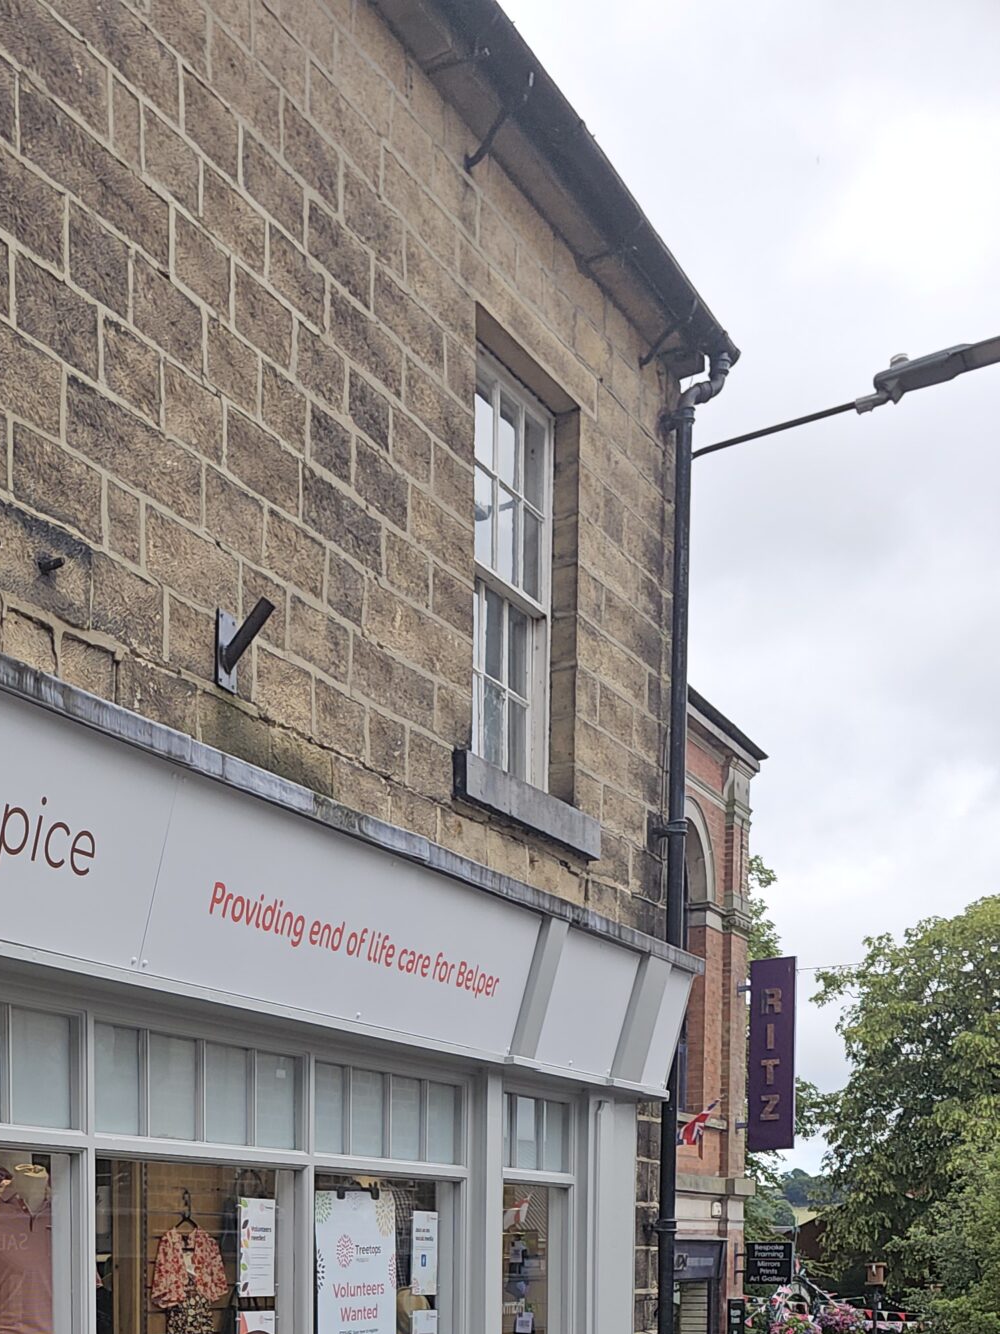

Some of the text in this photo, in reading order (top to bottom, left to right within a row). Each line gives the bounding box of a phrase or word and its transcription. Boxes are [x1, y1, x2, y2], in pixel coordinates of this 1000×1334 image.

[209, 881, 500, 998] Providing end of life care for Belper
[760, 987, 782, 1121] RITZ
[355, 1244, 381, 1256] Treetops
[333, 1282, 385, 1298] Volunteers
[340, 1303, 378, 1322] Wanted
